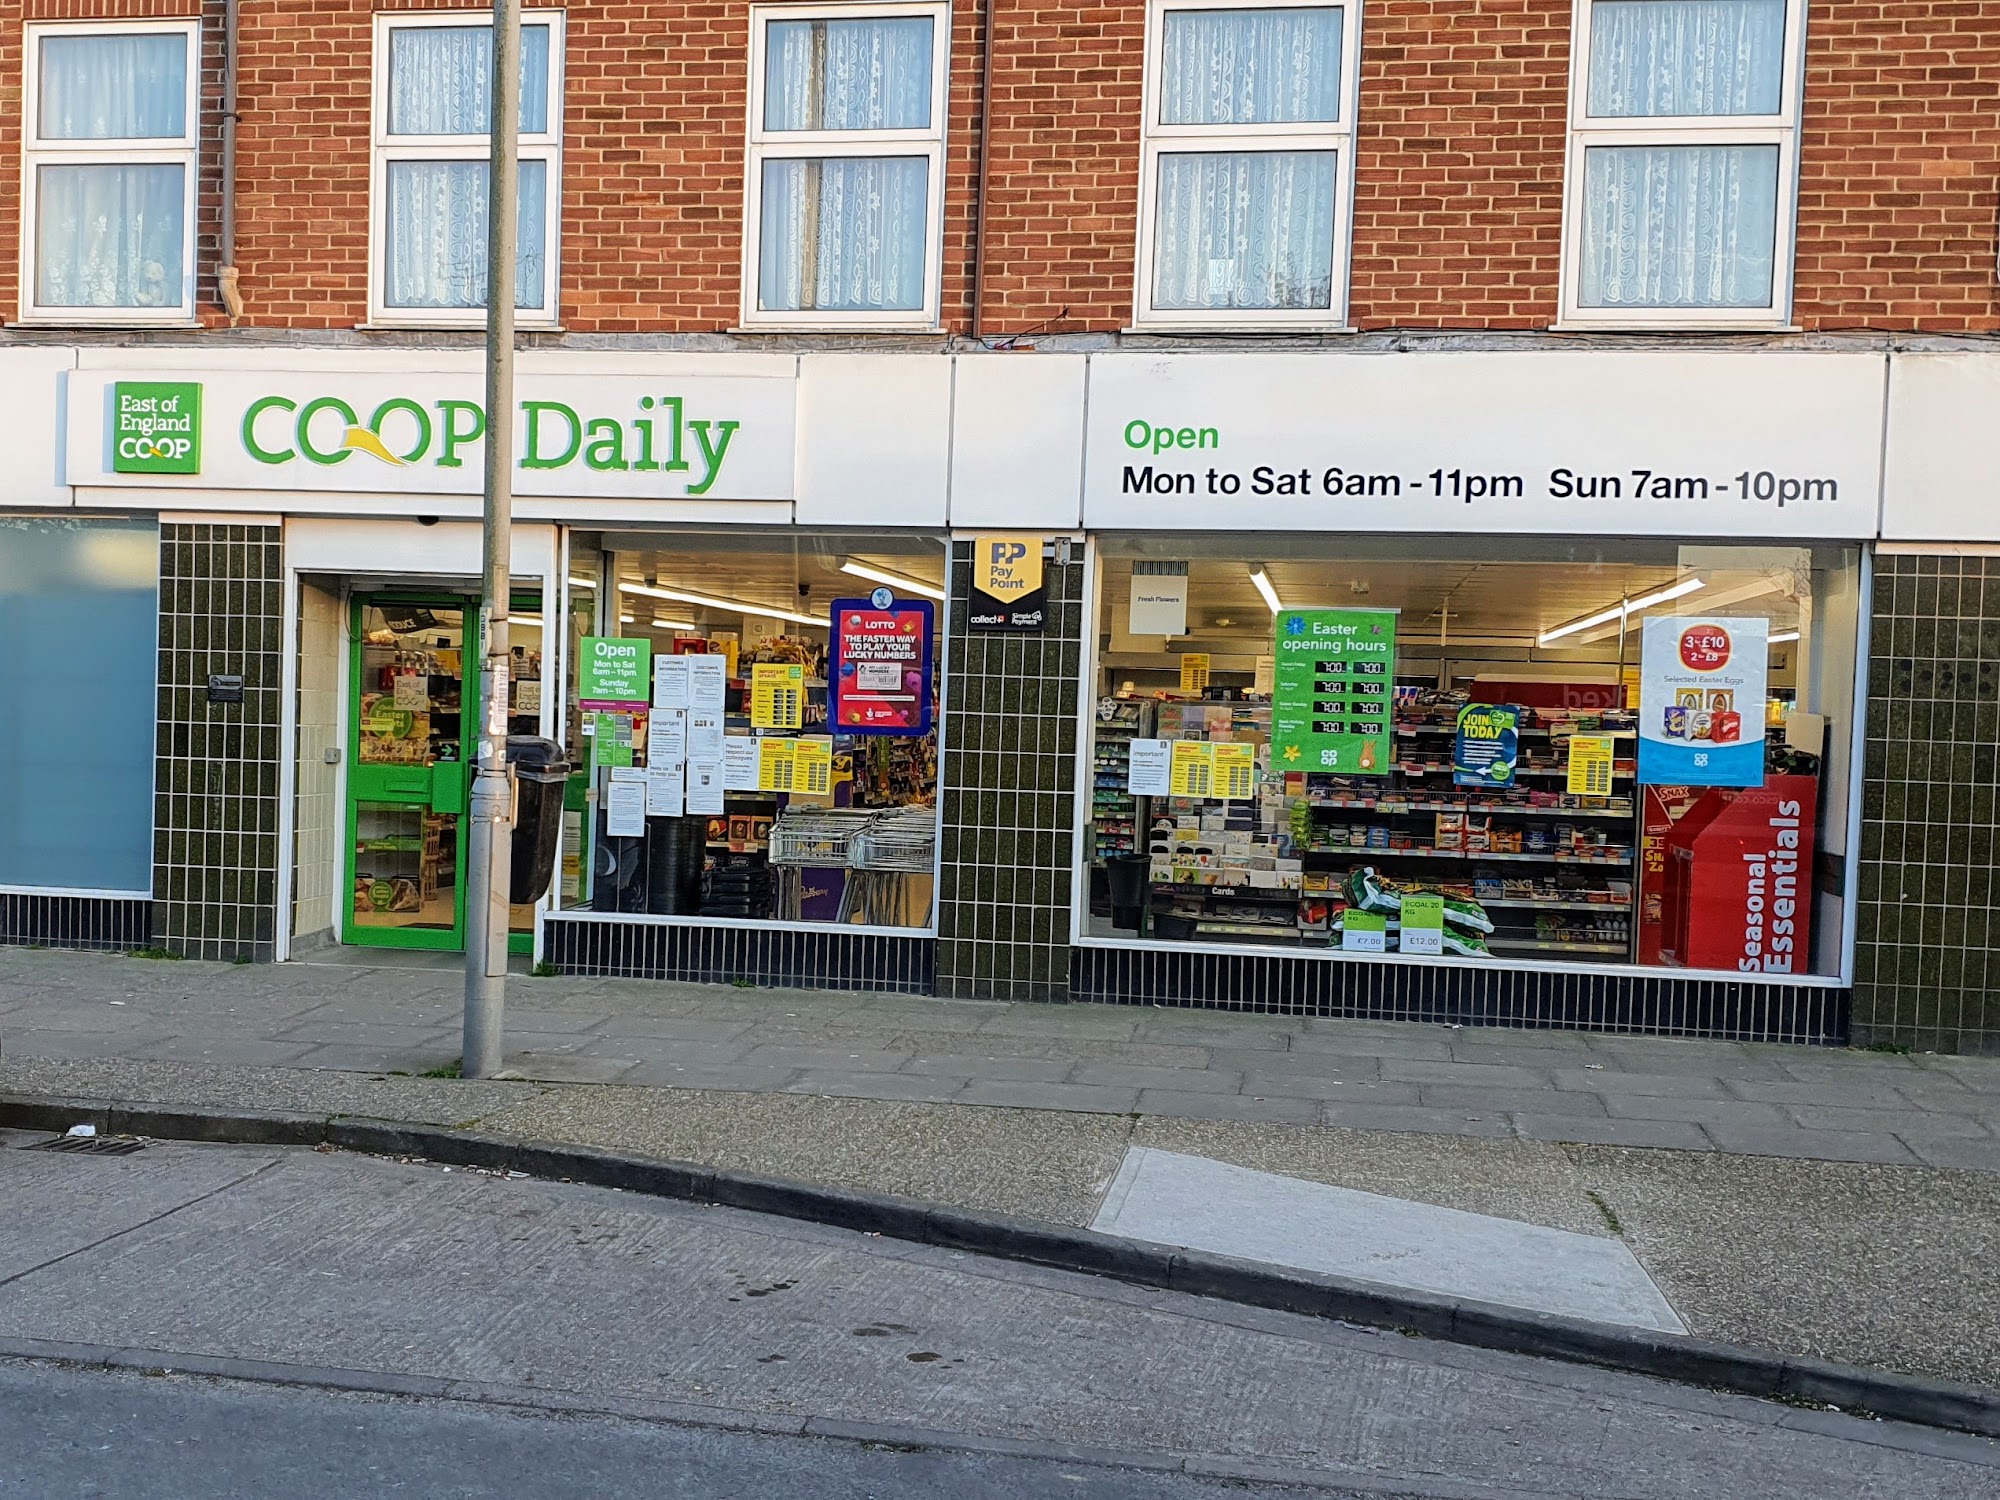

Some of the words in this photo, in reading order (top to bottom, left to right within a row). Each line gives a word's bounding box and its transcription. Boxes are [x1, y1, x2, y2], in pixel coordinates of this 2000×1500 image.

[120, 394, 158, 412] East
[161, 395, 180, 412] of
[120, 413, 190, 436] England
[1124, 420, 1219, 455] Open
[119, 437, 191, 459] COOP
[241, 396, 485, 468] COOP
[521, 396, 742, 496] Daily
[1122, 466, 1195, 494] Mon
[1206, 468, 1240, 495] to
[1250, 467, 1312, 495] Sat
[1322, 467, 1401, 496] 6am
[1429, 469, 1524, 504] 11pm
[1548, 468, 1622, 499] Sun
[1631, 470, 1708, 499] 7am
[1735, 471, 1838, 507] 10pm
[990, 566, 1013, 579] Pay
[990, 578, 1024, 588] Point
[865, 621, 895, 629] LOTTO
[1312, 622, 1358, 635] Easter
[844, 635, 861, 643] THE
[862, 635, 895, 643] FASTER
[896, 635, 916, 643] WAY
[1685, 636, 1694, 648] 3
[1701, 636, 1725, 648] £10
[595, 642, 636, 659] Open
[863, 643, 885, 651] PLAY
[885, 643, 910, 651] YOUR
[1282, 638, 1342, 654] opening
[1346, 638, 1387, 651] hours
[844, 651, 873, 659] LUCKY
[874, 651, 916, 659] NUMBERS
[1690, 652, 1698, 661] 2
[1705, 652, 1718, 661] £8
[594, 660, 611, 668] Mon
[613, 660, 621, 668] to
[617, 669, 636, 677] 11pm
[599, 678, 629, 688] Sunday
[1724, 677, 1744, 685] Eggs
[615, 687, 636, 695] 10pm
[1463, 714, 1489, 726] JOIN
[1463, 725, 1503, 739] TODAY
[1660, 787, 1688, 800] SNAX
[1211, 886, 1235, 896] Cards
[1763, 800, 1800, 974] Essentials
[1738, 854, 1767, 972] Seasonal
[1357, 937, 1380, 945] £7.00
[1410, 937, 1438, 946] £12.00
